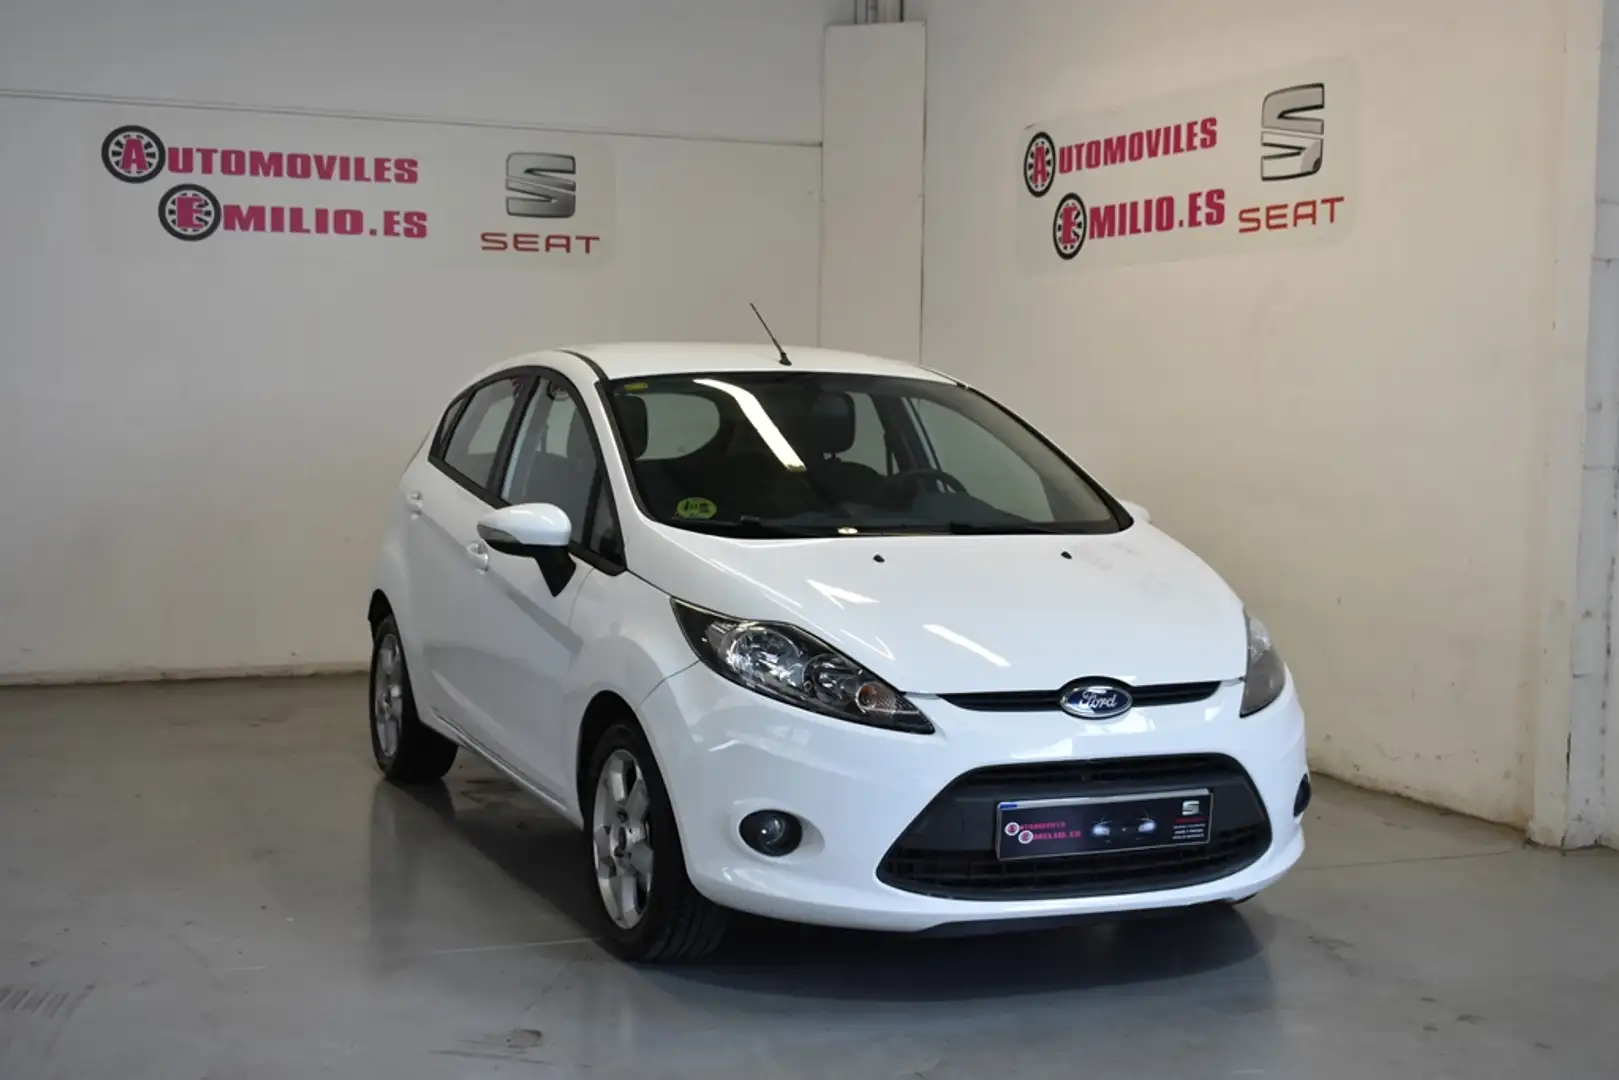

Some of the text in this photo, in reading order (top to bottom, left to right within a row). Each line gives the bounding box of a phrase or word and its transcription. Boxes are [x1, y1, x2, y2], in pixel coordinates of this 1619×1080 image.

[119, 137, 420, 184] AUTOMOVILES
[1032, 116, 1218, 185] AUTOMOVILES
[175, 196, 429, 239] EMILIO.ES
[1061, 188, 1226, 245] EMILIO.ES
[1237, 196, 1345, 234] SEAT
[480, 232, 601, 254] SEAT
[1081, 688, 1118, 709] Ford
